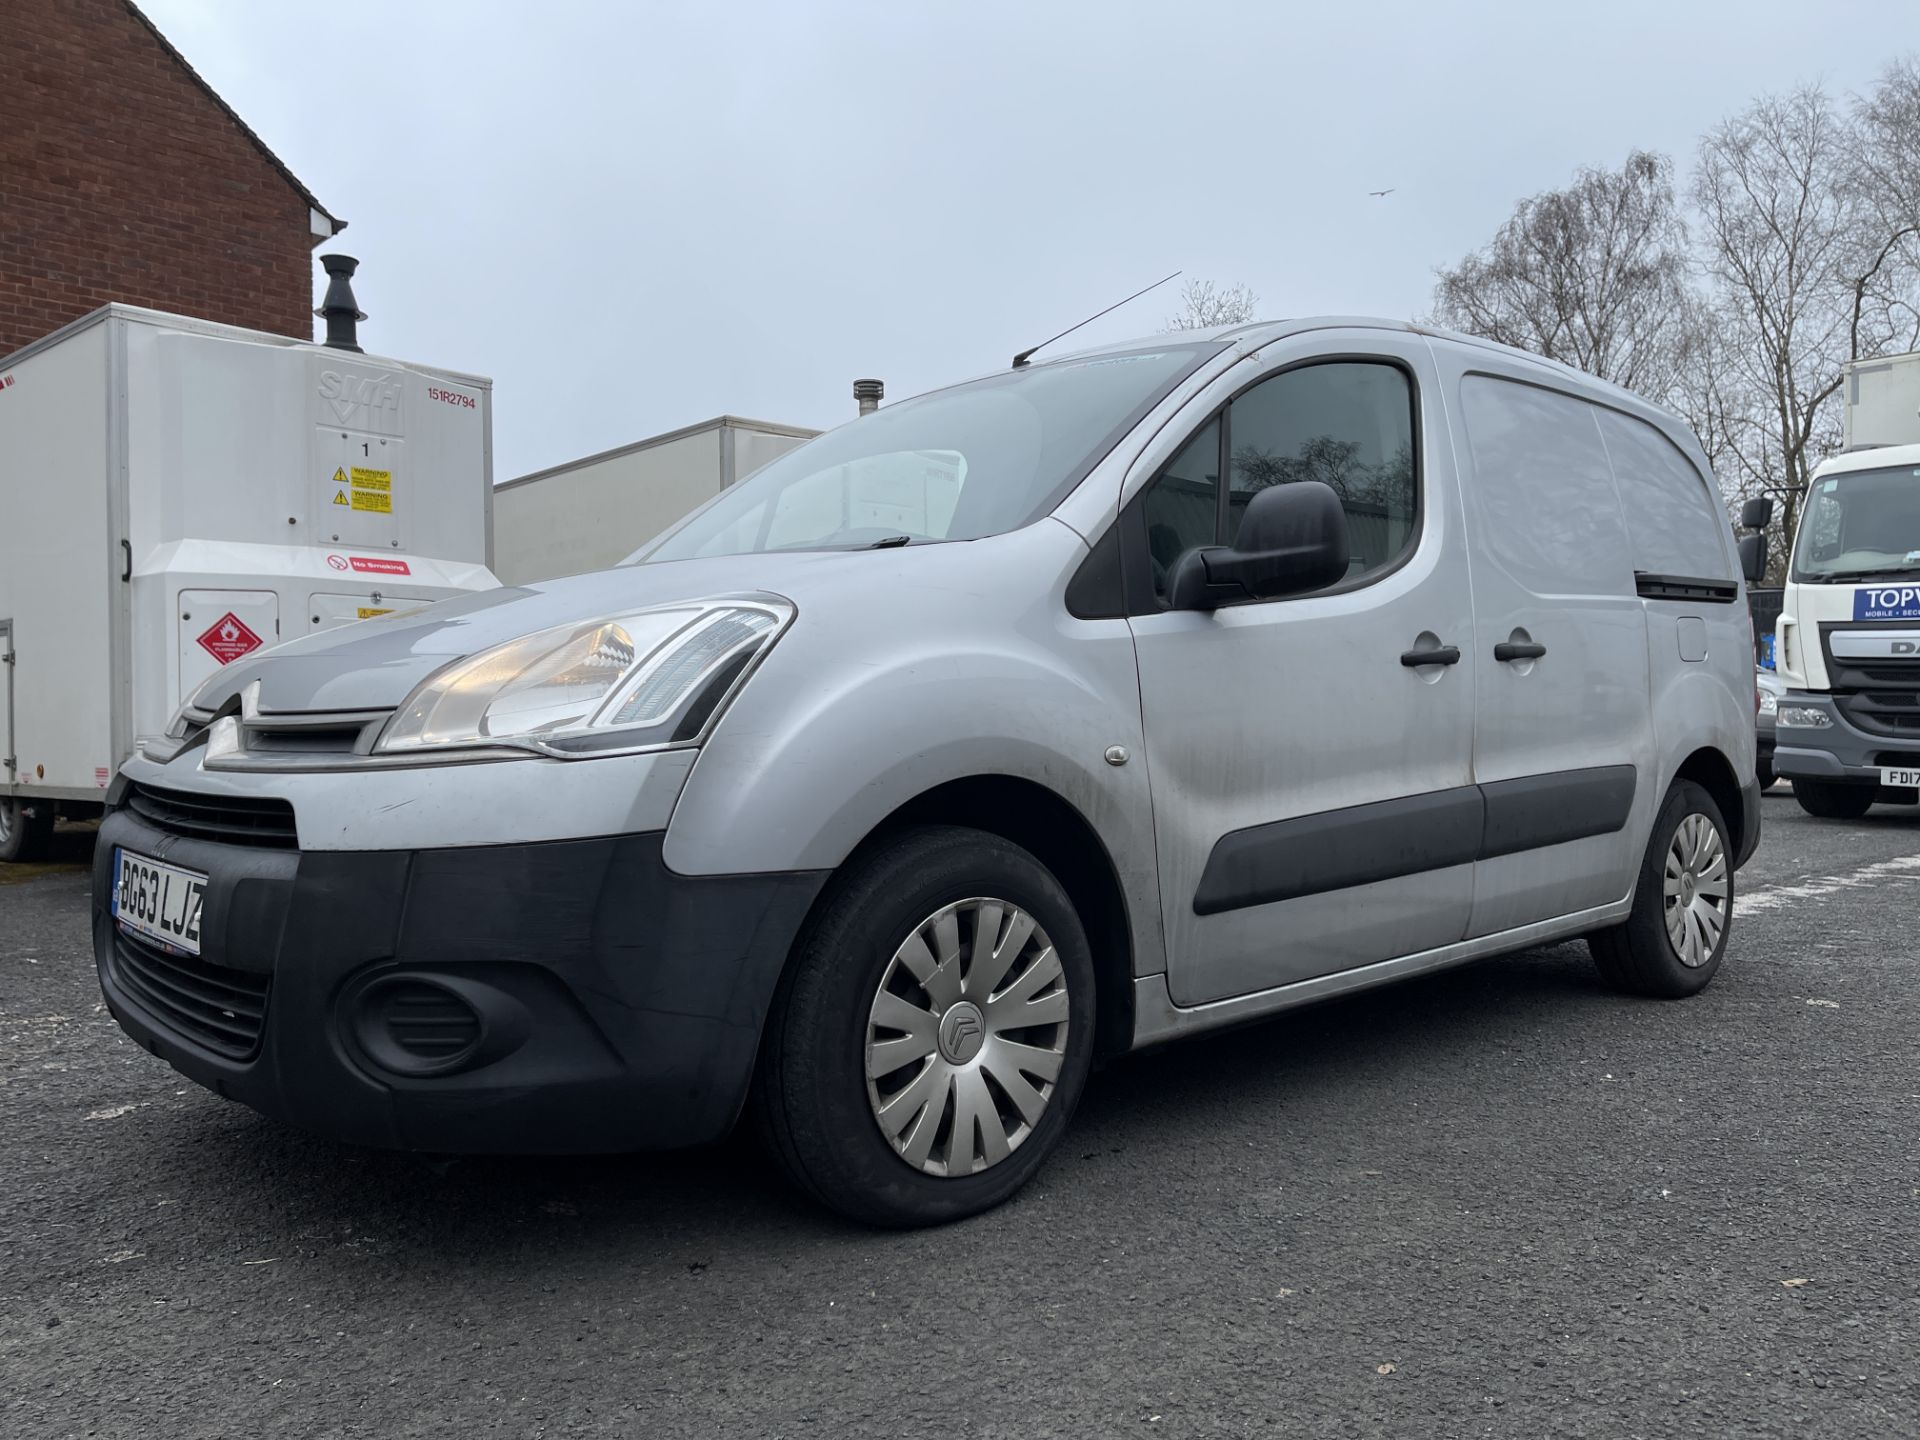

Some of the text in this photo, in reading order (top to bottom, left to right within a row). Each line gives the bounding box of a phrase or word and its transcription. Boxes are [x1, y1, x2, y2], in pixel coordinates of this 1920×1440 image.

[427, 387, 476, 409] 151R2794
[361, 443, 369, 457] 1
[353, 467, 388, 478] WARNING
[353, 490, 388, 500] WARNING
[367, 562, 405, 571] Smoking
[1865, 610, 1893, 618] MOBILE
[1889, 771, 1920, 785] FD17
[120, 860, 159, 924] BG63
[160, 874, 207, 942] LJZ
